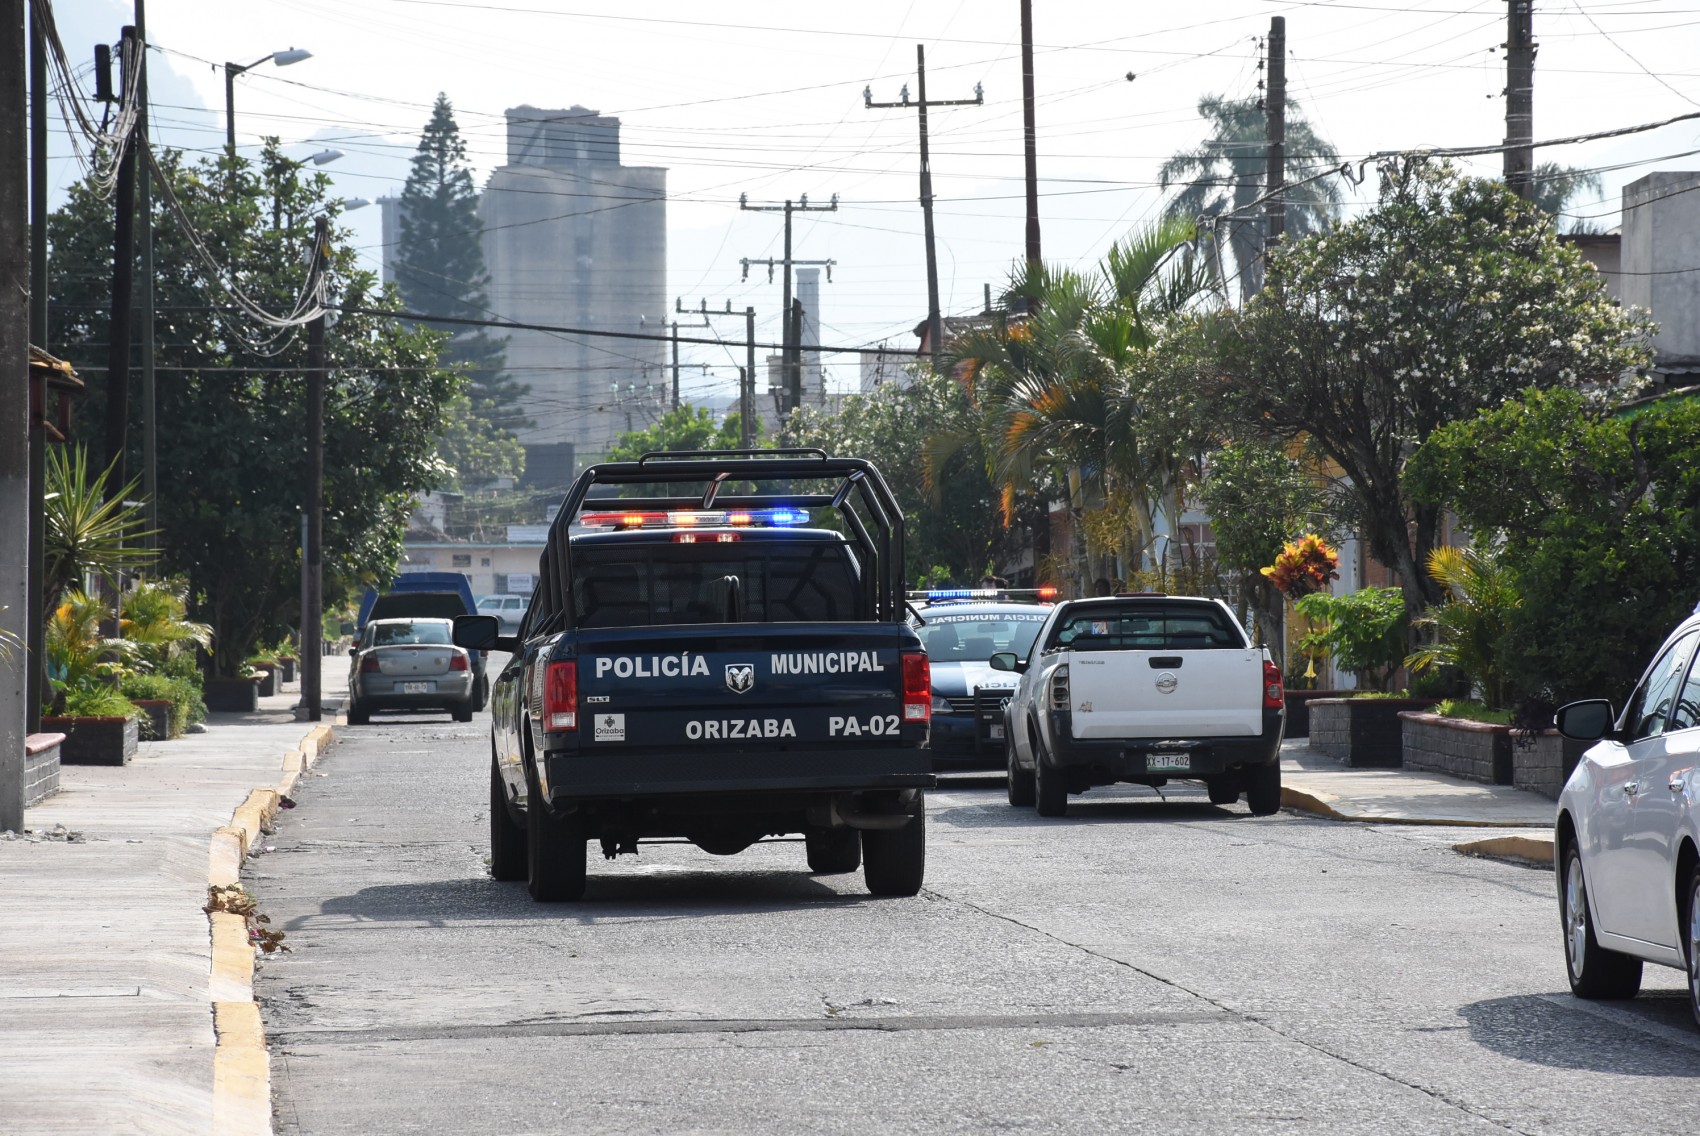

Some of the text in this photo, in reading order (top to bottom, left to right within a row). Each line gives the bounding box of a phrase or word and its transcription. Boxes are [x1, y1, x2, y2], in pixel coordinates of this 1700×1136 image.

[596, 652, 883, 677] POLICÍA MUNICIPAL
[595, 727, 625, 735] Orizaba
[686, 715, 899, 739] ORIZABA PA-02
[1147, 756, 1190, 767] XX-17-602
